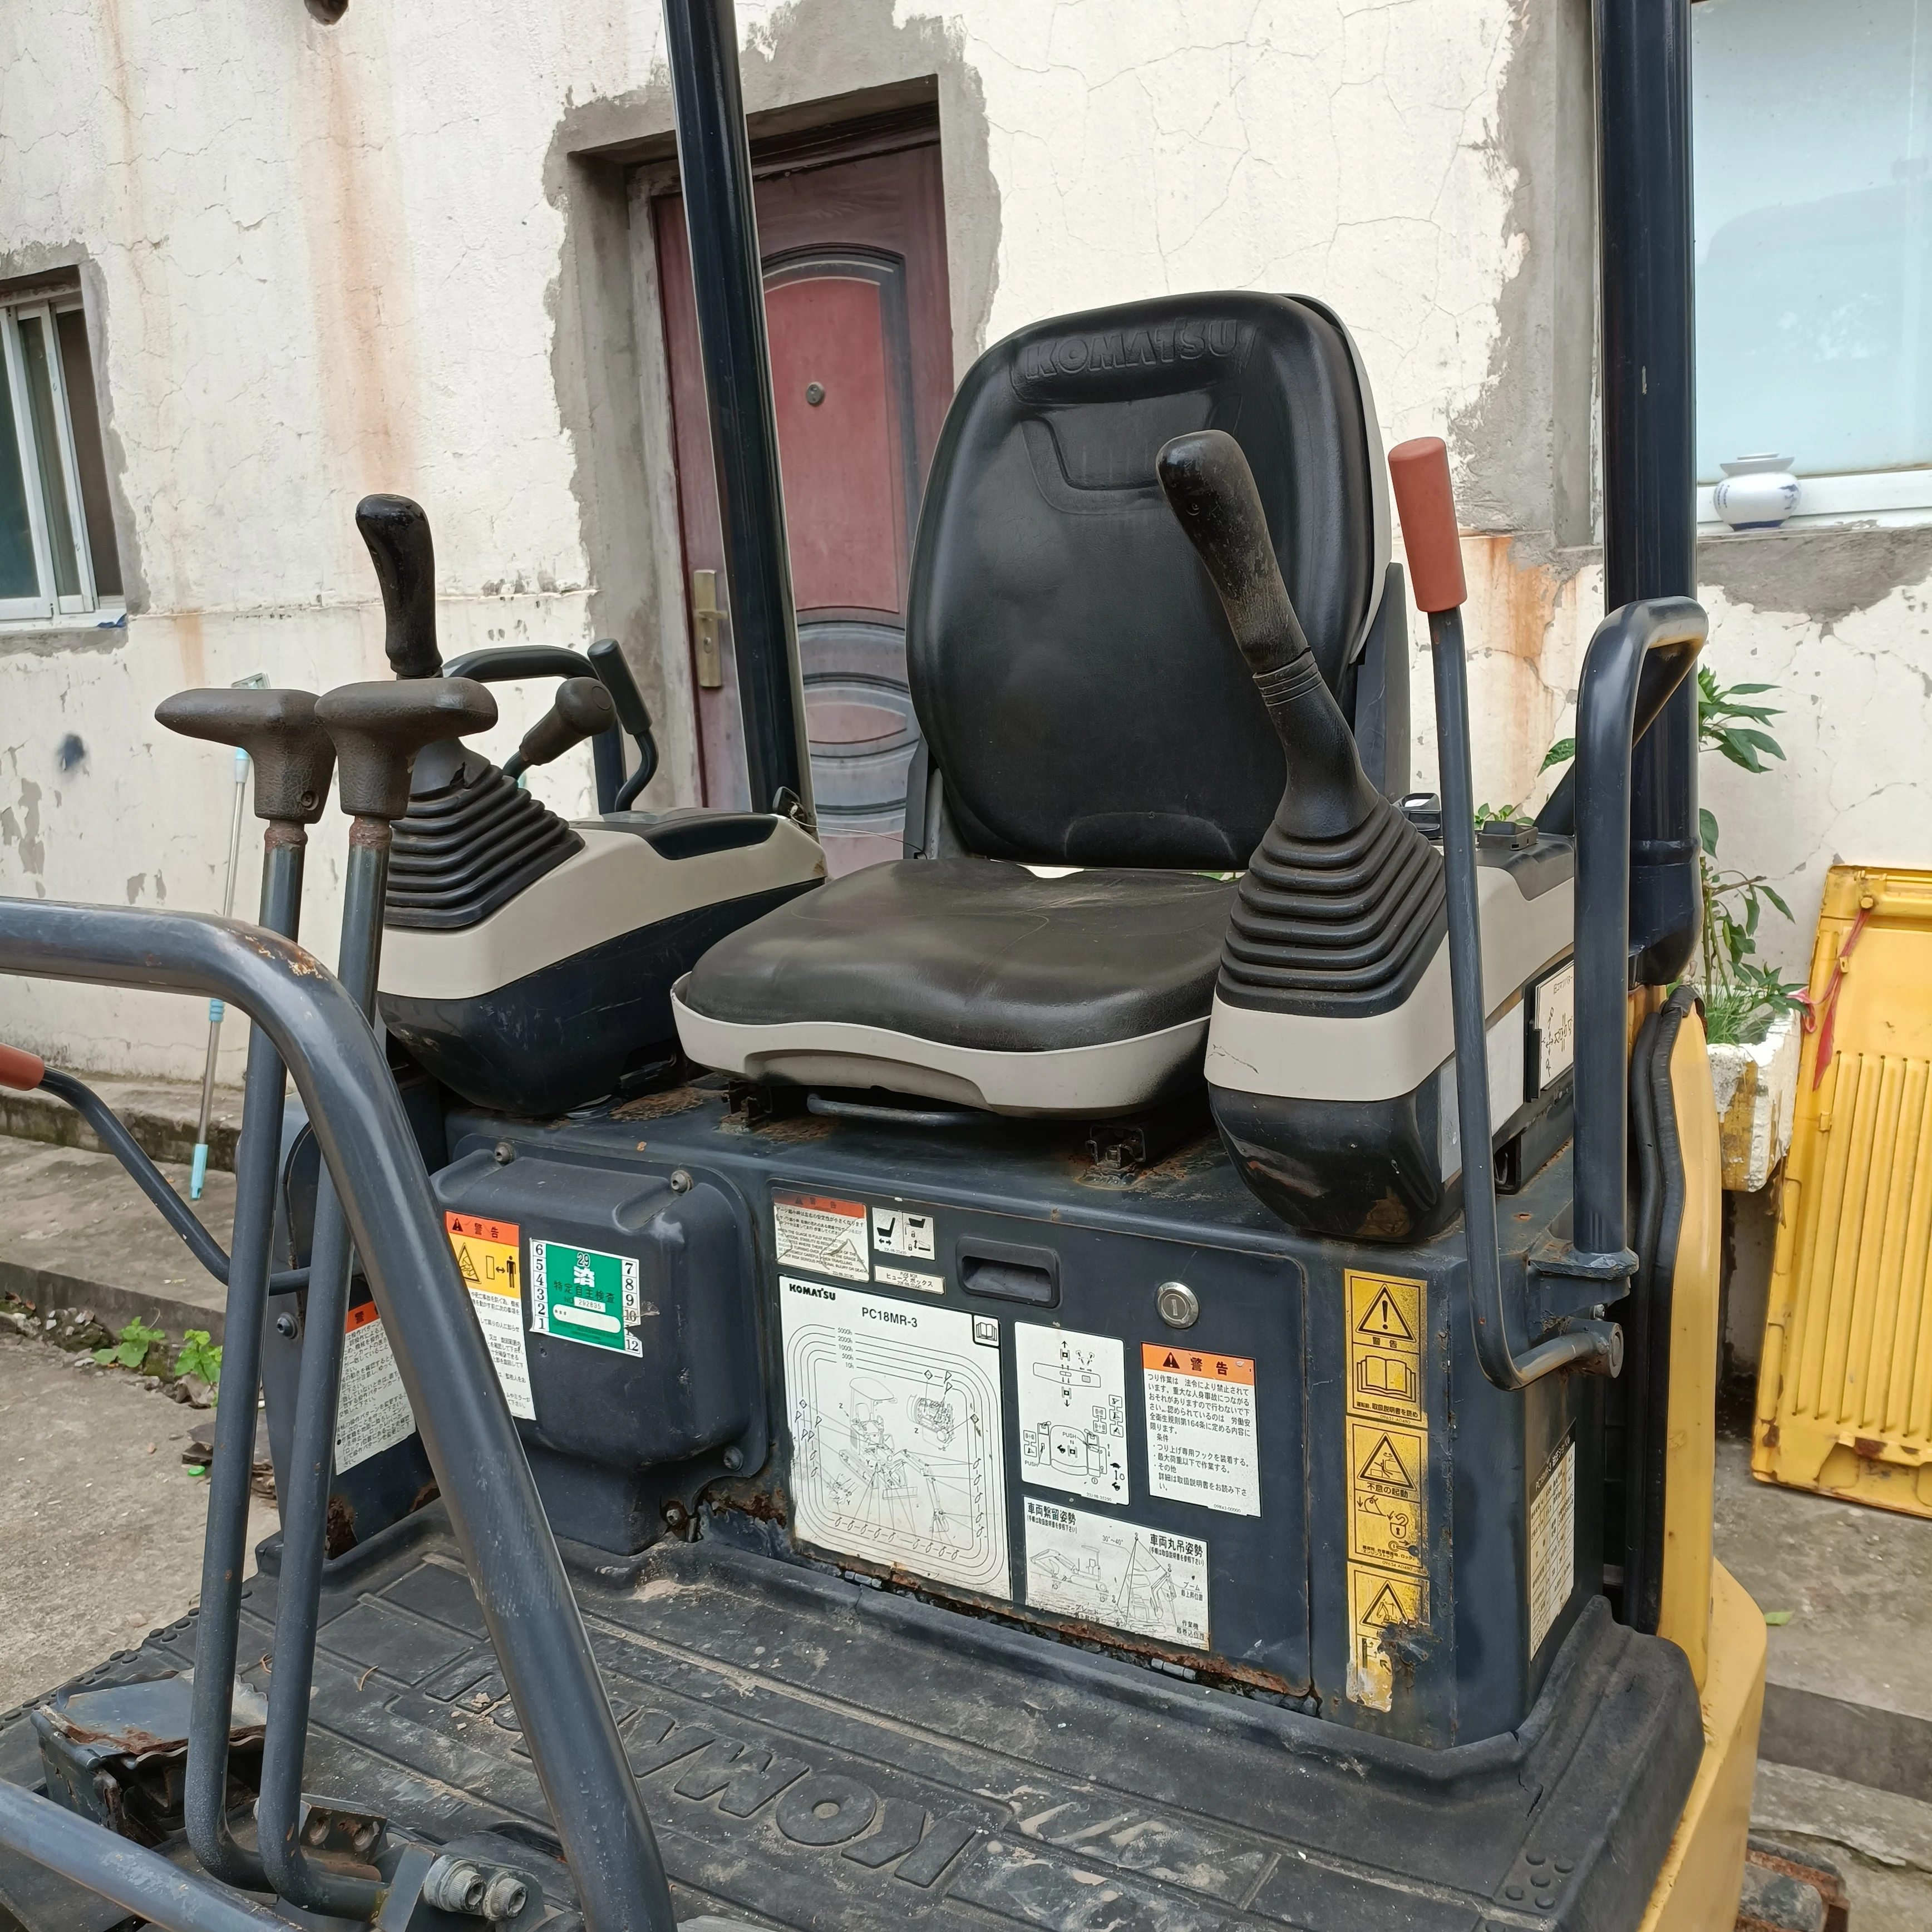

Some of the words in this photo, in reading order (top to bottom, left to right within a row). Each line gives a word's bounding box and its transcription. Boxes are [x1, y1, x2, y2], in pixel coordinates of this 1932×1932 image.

[1024, 318, 1239, 379] KOMATSU
[475, 1223, 499, 1239] 警告
[536, 1244, 543, 1255] 6
[536, 1259, 543, 1270] 5
[577, 1252, 590, 1268] 29
[625, 1262, 633, 1274] 7
[536, 1274, 544, 1286] 4
[574, 1265, 595, 1288] 済
[625, 1278, 634, 1291] 8
[537, 1288, 544, 1300] 3
[554, 1280, 615, 1304] 特定自主検査
[789, 1284, 836, 1300] KOMATSU
[625, 1294, 634, 1306] 9
[538, 1303, 545, 1315] 2
[625, 1309, 637, 1322] 10
[862, 1307, 918, 1328] PC18MR-3
[539, 1318, 546, 1329] 1
[837, 1327, 852, 1335] 5000h
[626, 1339, 638, 1351] 12
[837, 1335, 852, 1344] 2000h
[1372, 1337, 1398, 1348] 警告
[839, 1344, 854, 1352] 1000h
[1190, 1357, 1228, 1376] 警告
[1148, 1373, 1179, 1385] つり作業は
[1184, 1378, 1249, 1396] 法令により禁止されて
[1149, 1393, 1250, 1417] おそれがありますので行わないで下
[1150, 1422, 1177, 1435] 限ります。
[1157, 1433, 1169, 1442] 条件
[1367, 1482, 1408, 1498] 不意の起動
